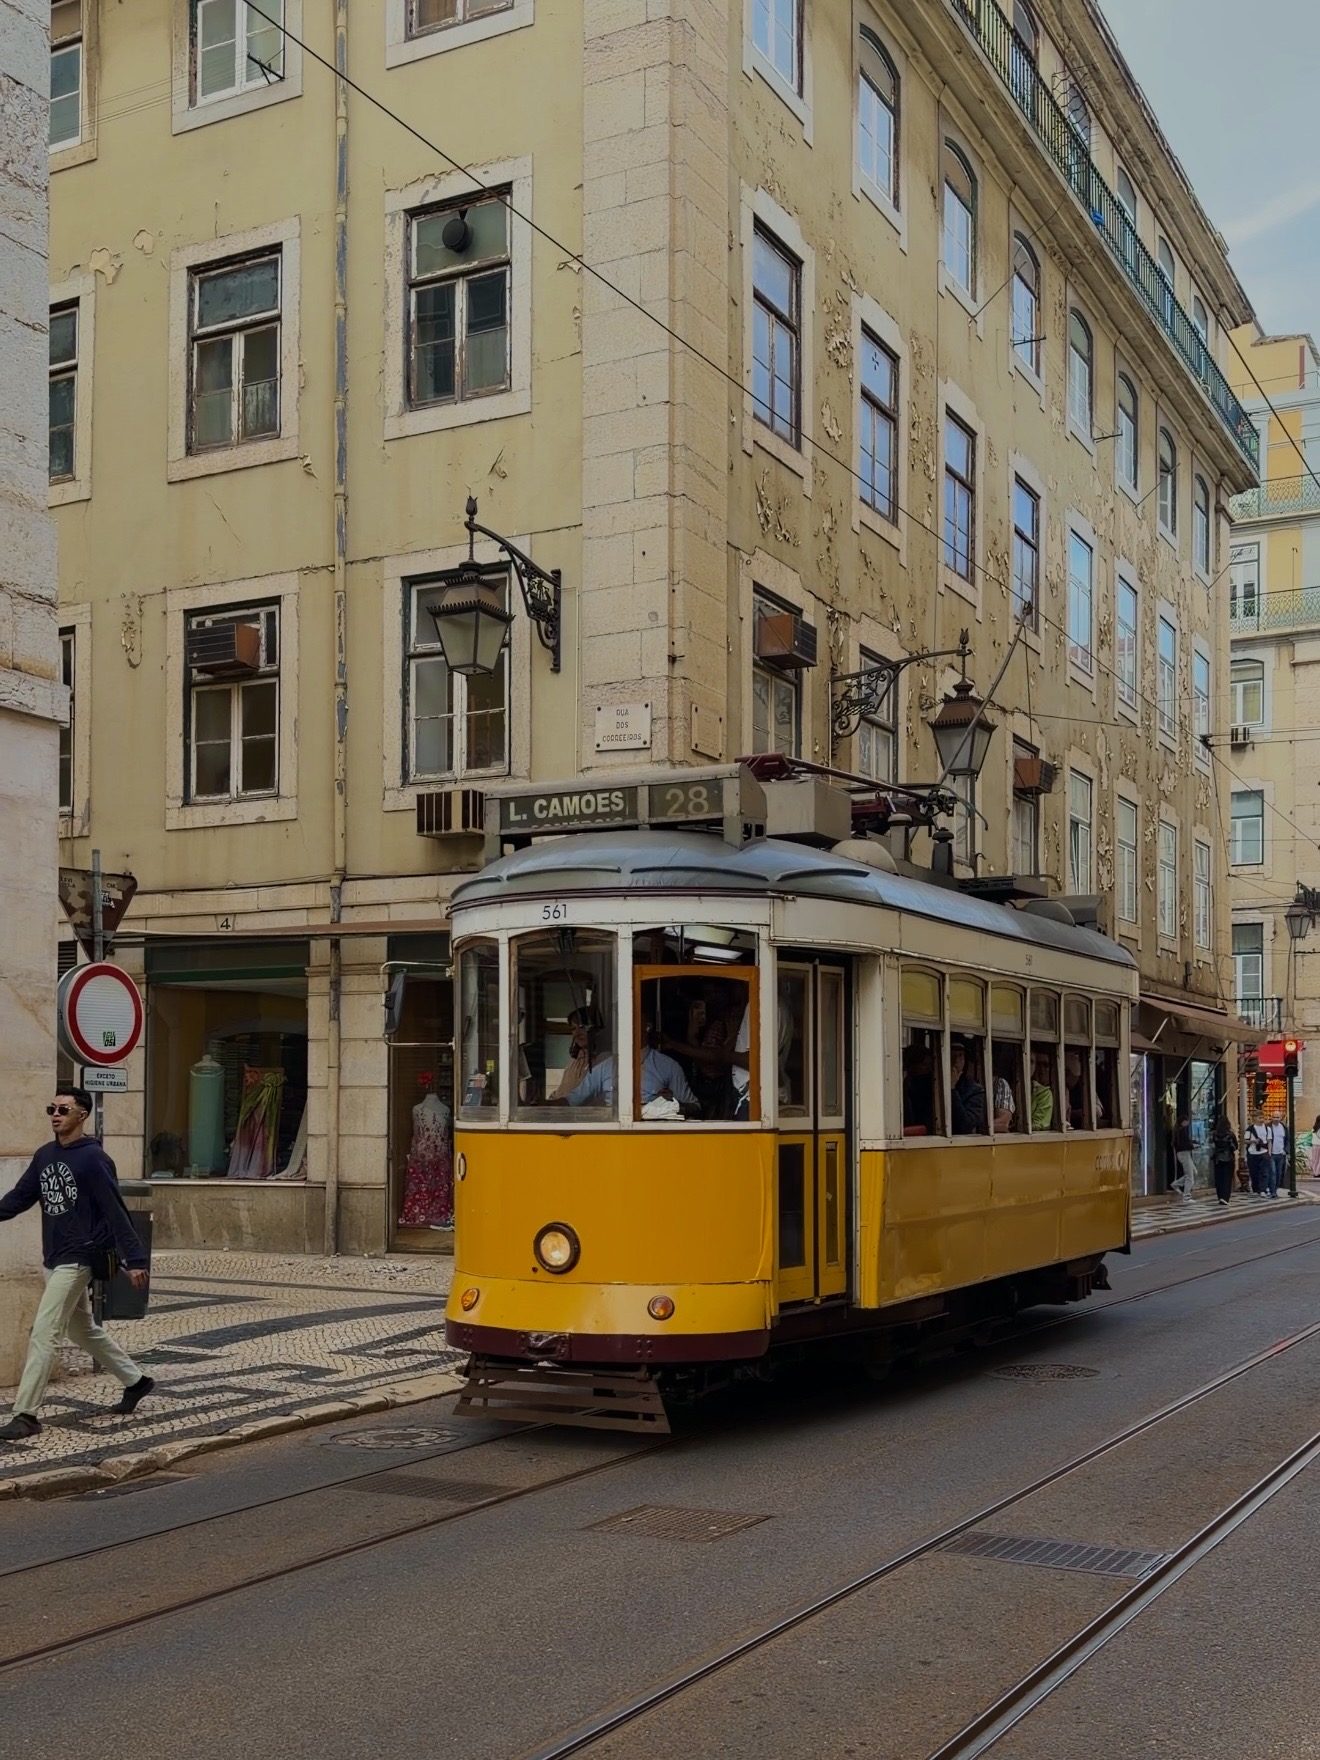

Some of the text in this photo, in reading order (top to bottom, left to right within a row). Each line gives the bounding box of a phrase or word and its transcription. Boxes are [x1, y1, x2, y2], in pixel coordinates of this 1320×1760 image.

[665, 786, 709, 817] 28
[509, 802, 527, 821] L.
[541, 903, 568, 920] 561
[220, 917, 231, 930] 4
